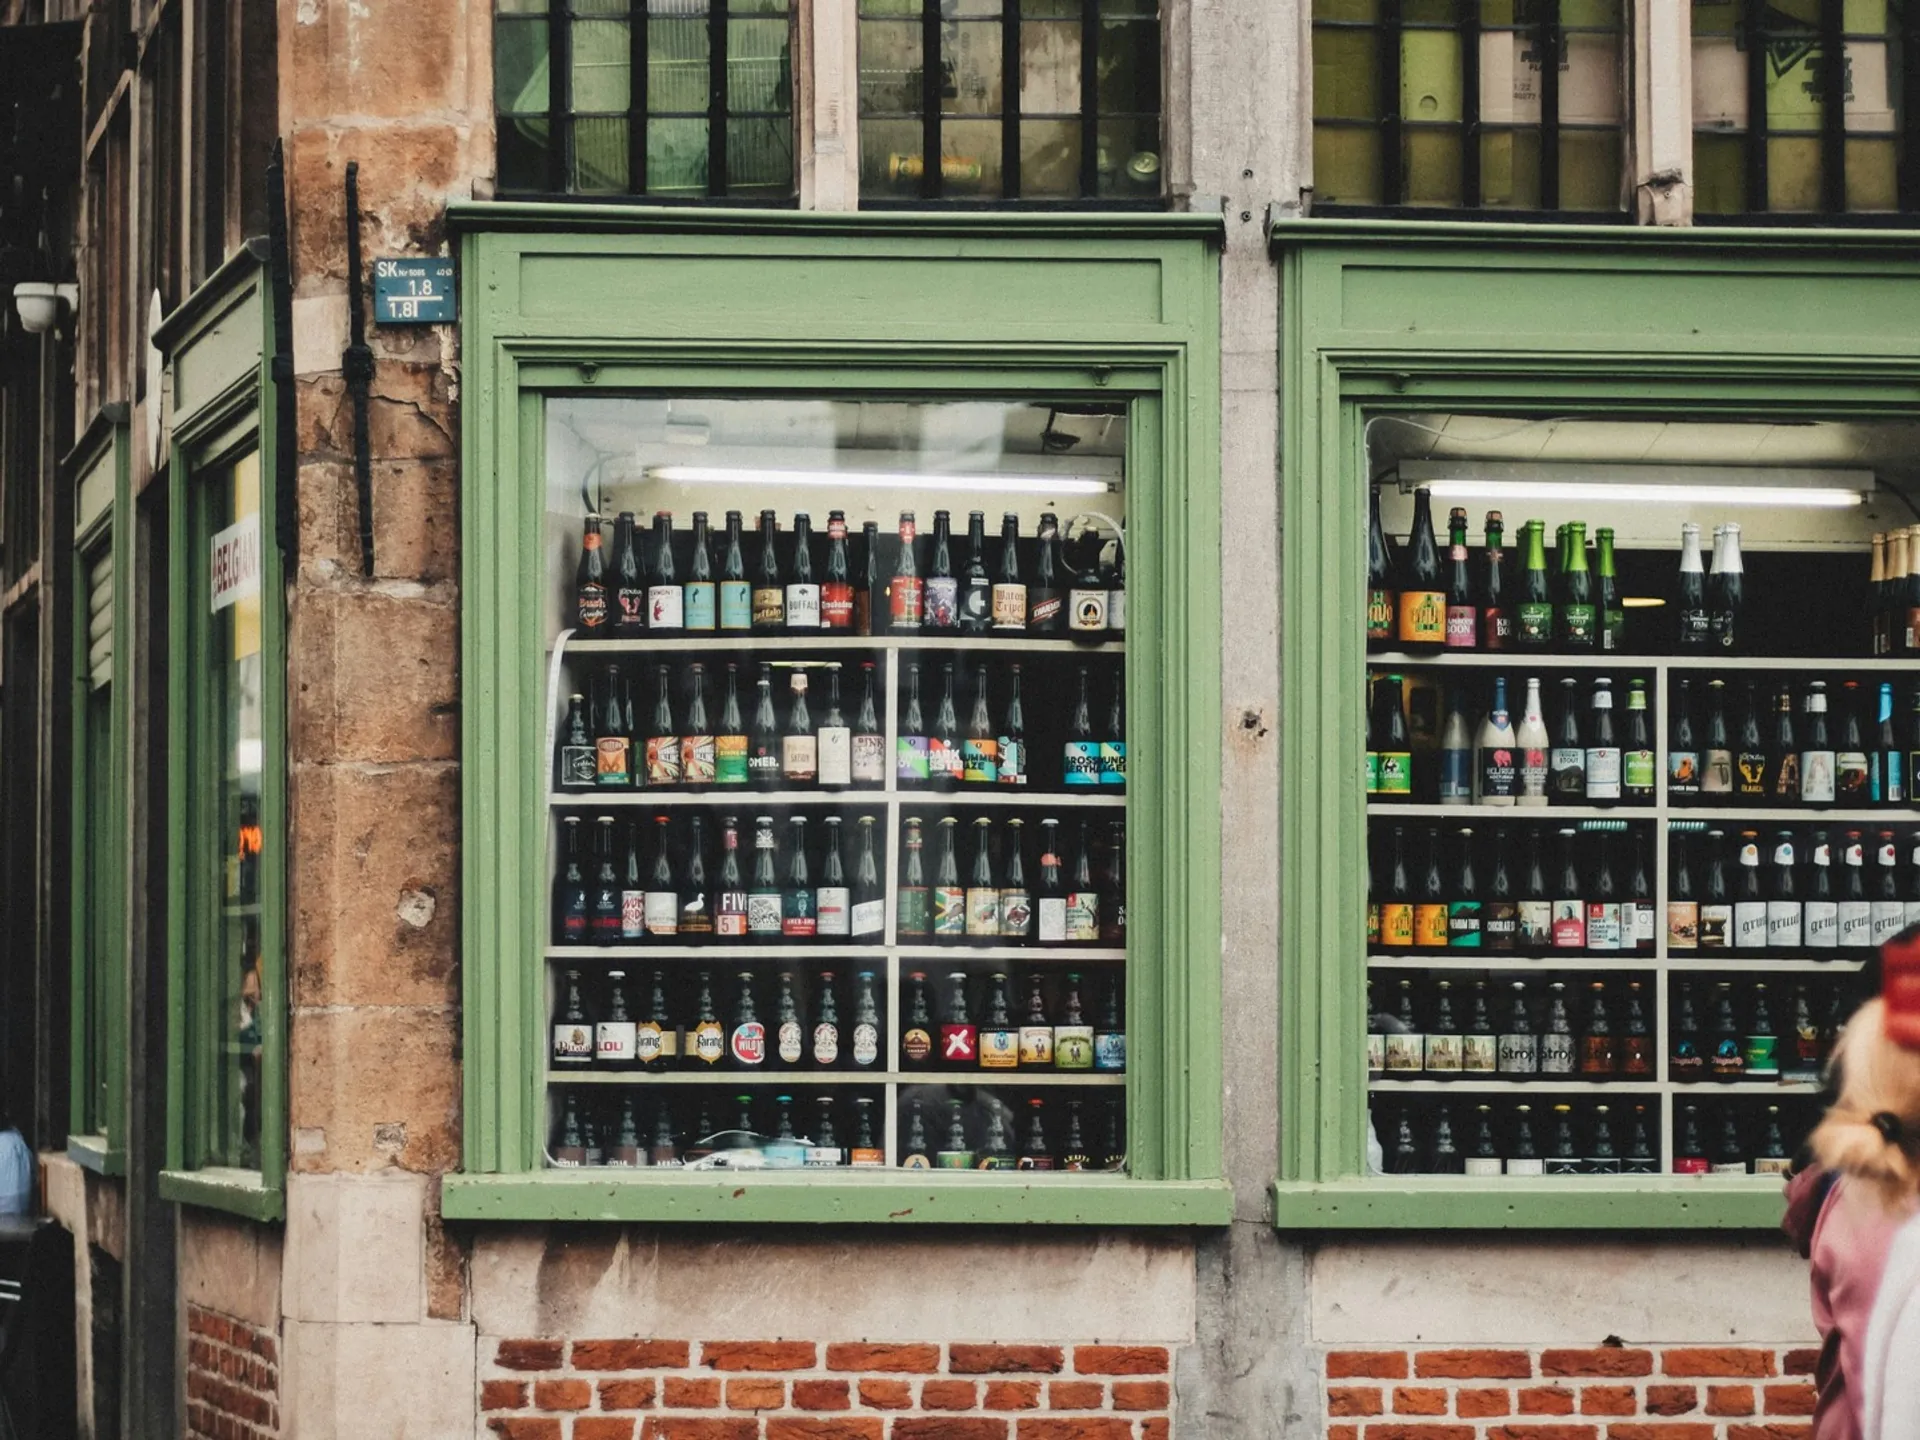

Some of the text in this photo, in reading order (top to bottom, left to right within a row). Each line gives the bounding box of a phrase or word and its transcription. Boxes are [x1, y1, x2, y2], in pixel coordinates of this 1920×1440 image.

[378, 261, 398, 277] SK
[409, 279, 433, 296] 1.8
[748, 756, 779, 768] OMER.
